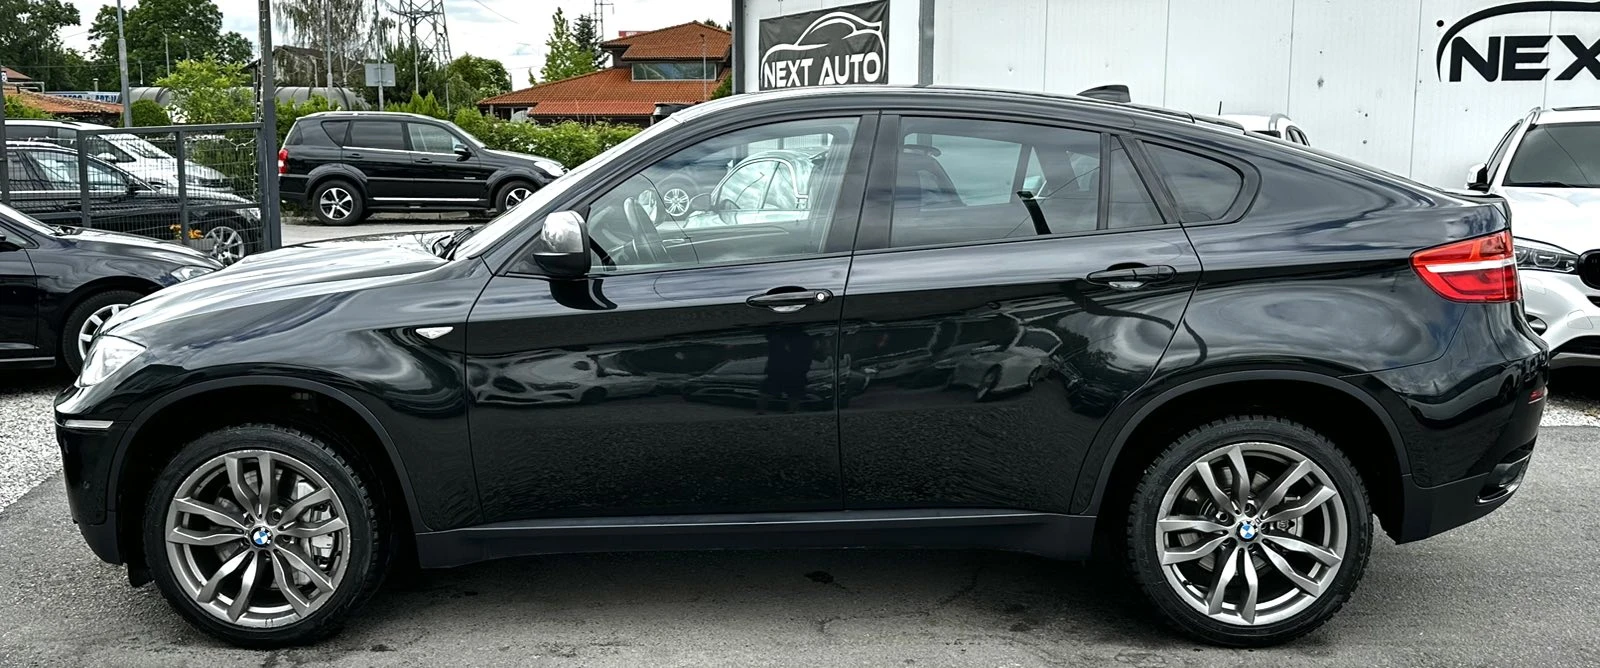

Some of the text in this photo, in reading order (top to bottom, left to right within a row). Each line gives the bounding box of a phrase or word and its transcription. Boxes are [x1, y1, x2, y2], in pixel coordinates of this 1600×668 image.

[764, 52, 881, 88] NEXT AUTO
[1449, 35, 1600, 82] NEX
